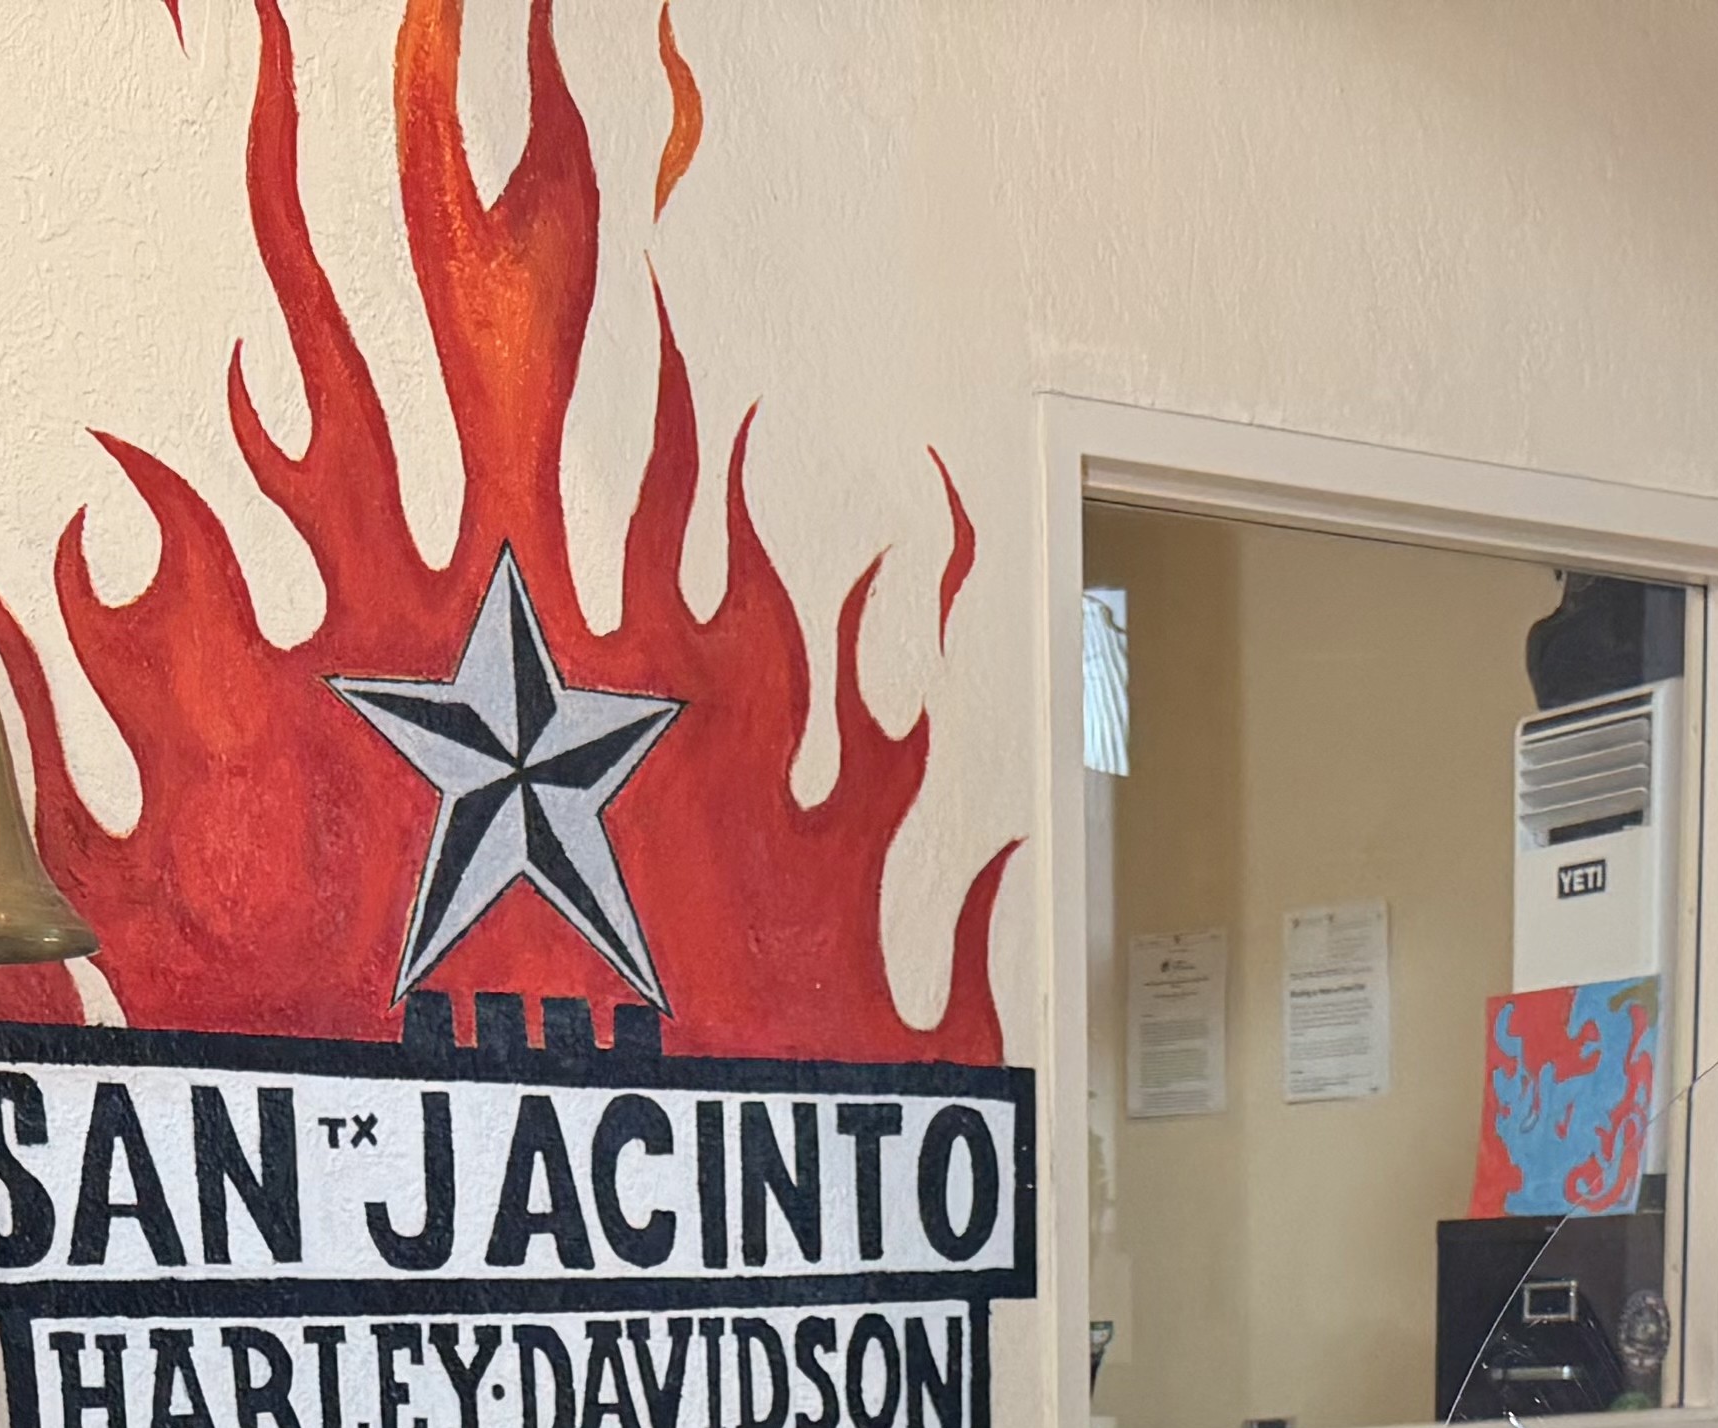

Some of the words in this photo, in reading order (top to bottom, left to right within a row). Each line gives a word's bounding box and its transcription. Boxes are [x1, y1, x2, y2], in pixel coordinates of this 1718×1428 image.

[1559, 865, 1606, 893] YETI
[319, 1113, 379, 1152] TX
[366, 1091, 1000, 1272] JACINTO
